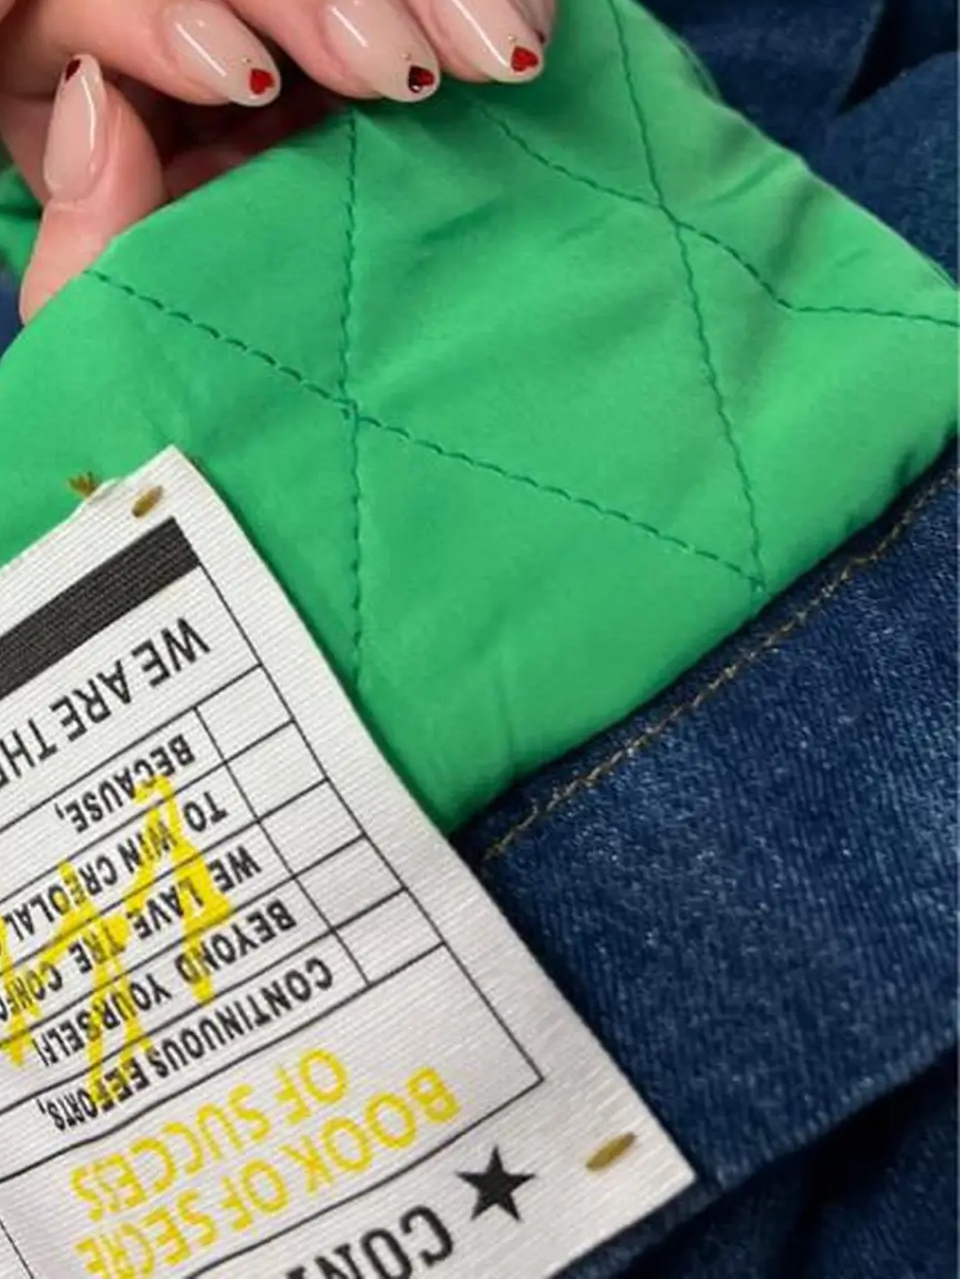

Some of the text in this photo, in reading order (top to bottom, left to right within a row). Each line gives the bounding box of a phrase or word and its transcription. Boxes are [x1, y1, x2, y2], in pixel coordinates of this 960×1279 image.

[130, 614, 211, 689] WE
[48, 659, 140, 741] ARE
[51, 733, 196, 836] BECAUSE,
[179, 788, 228, 837] TO
[115, 818, 176, 874] WIN
[207, 843, 259, 893] WE
[124, 875, 201, 942] LAVE
[172, 896, 297, 988] BEYOND
[143, 952, 335, 1081] CONTINUOUS
[67, 1041, 353, 1226] OF SUCCESS
[74, 1061, 462, 1279] BOOK OF SECRE
[284, 1201, 458, 1279] CON
